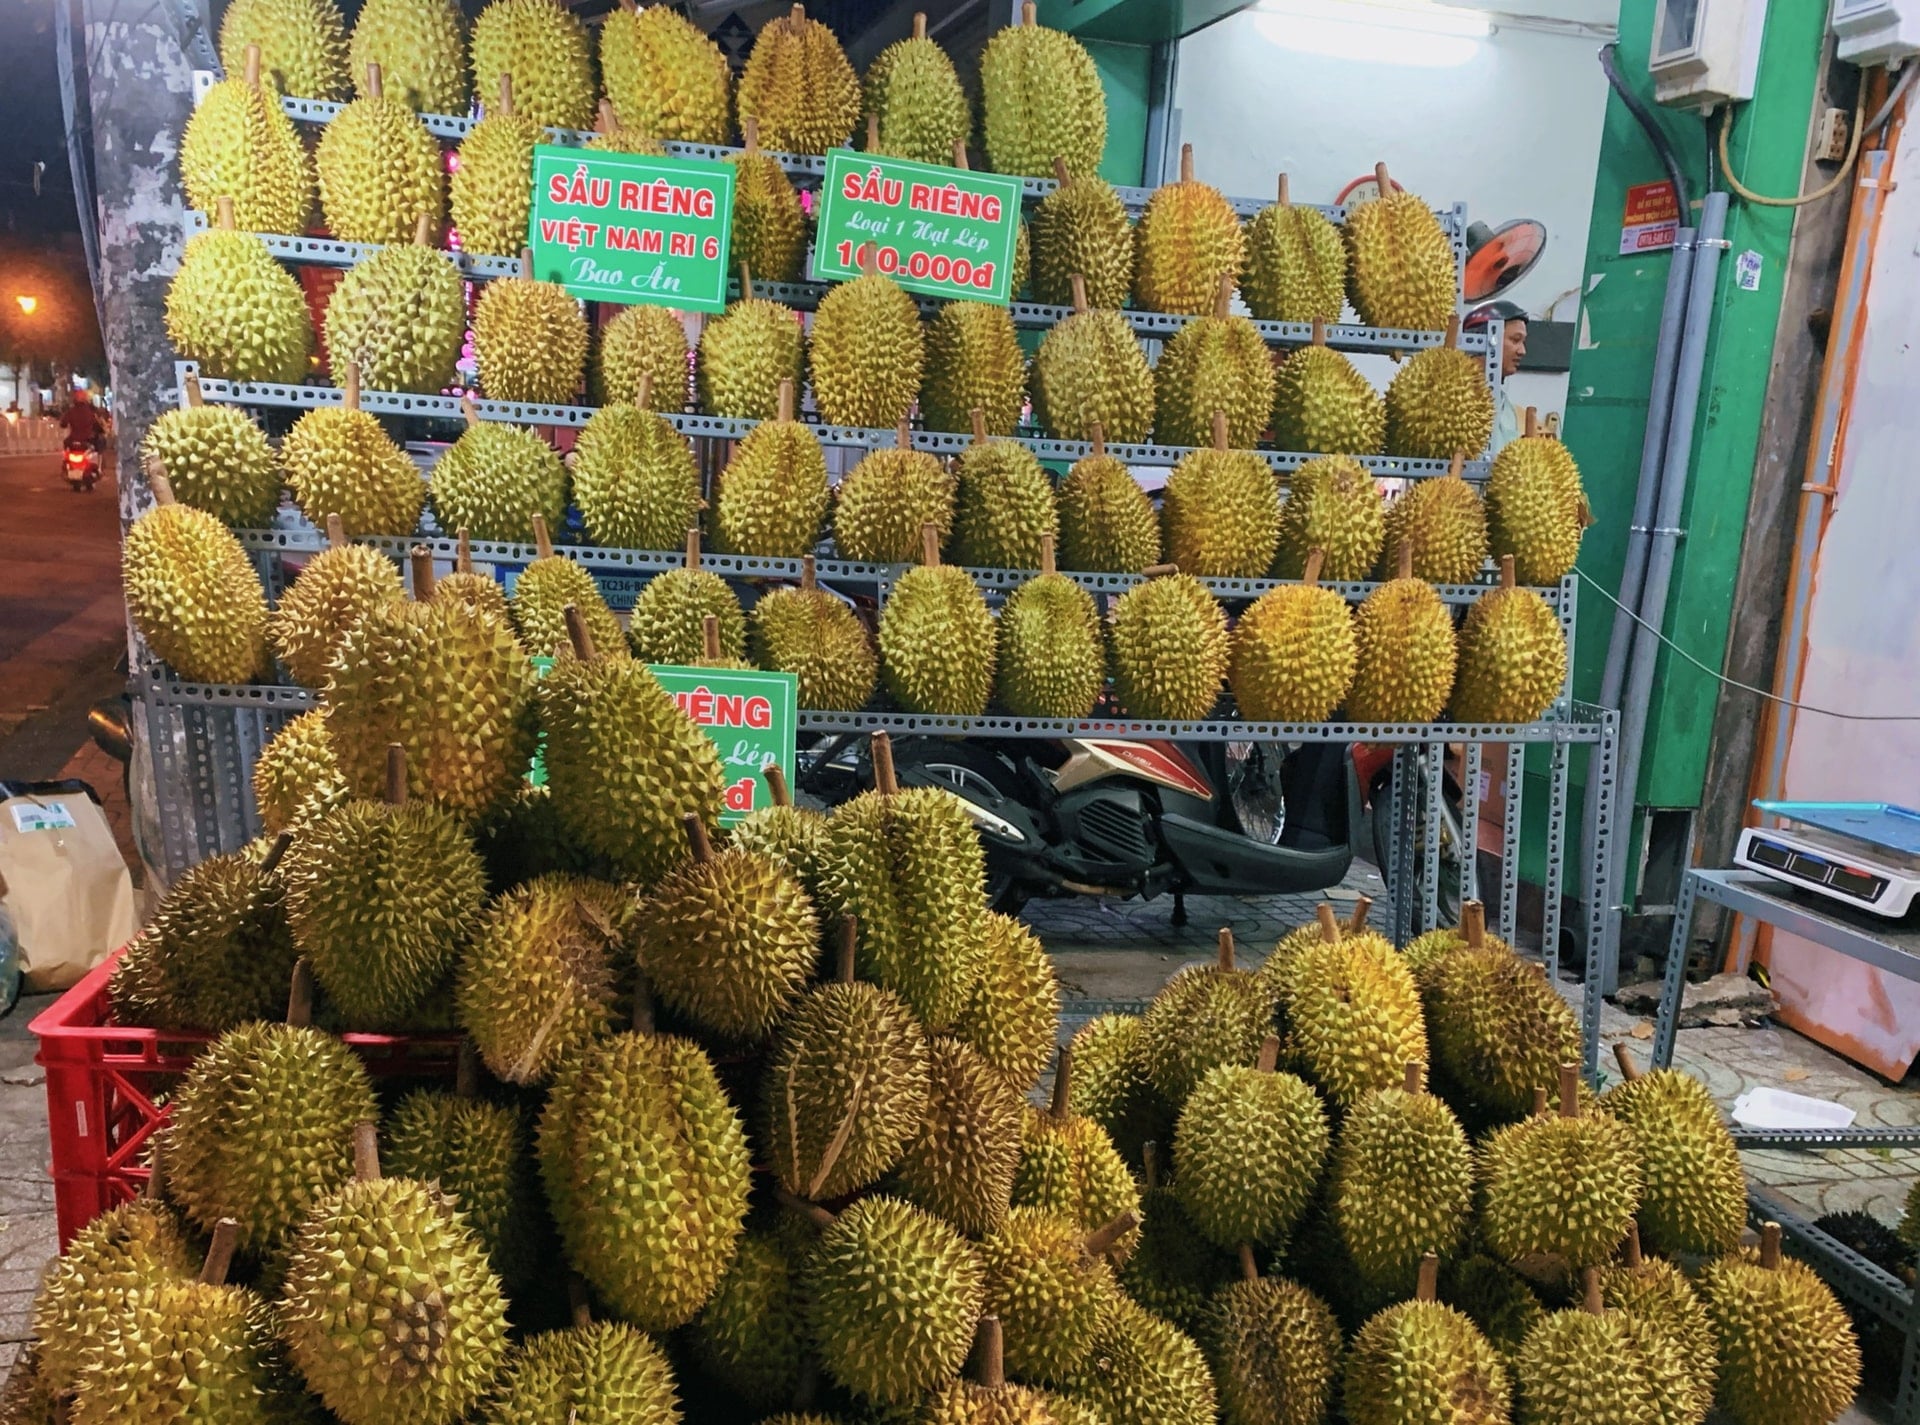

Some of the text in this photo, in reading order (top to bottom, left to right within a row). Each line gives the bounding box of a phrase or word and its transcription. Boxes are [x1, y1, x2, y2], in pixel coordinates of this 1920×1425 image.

[550, 164, 714, 218] SẦU RIÊNG
[843, 166, 1001, 222] SẦU RIÊNG
[540, 217, 718, 260] VIỆT NAM RI 6
[846, 211, 989, 252] Loại 1 Hạt Lép
[570, 257, 681, 292] Bao Ăn
[665, 686, 771, 729] IÊNG
[724, 740, 775, 772] Lép
